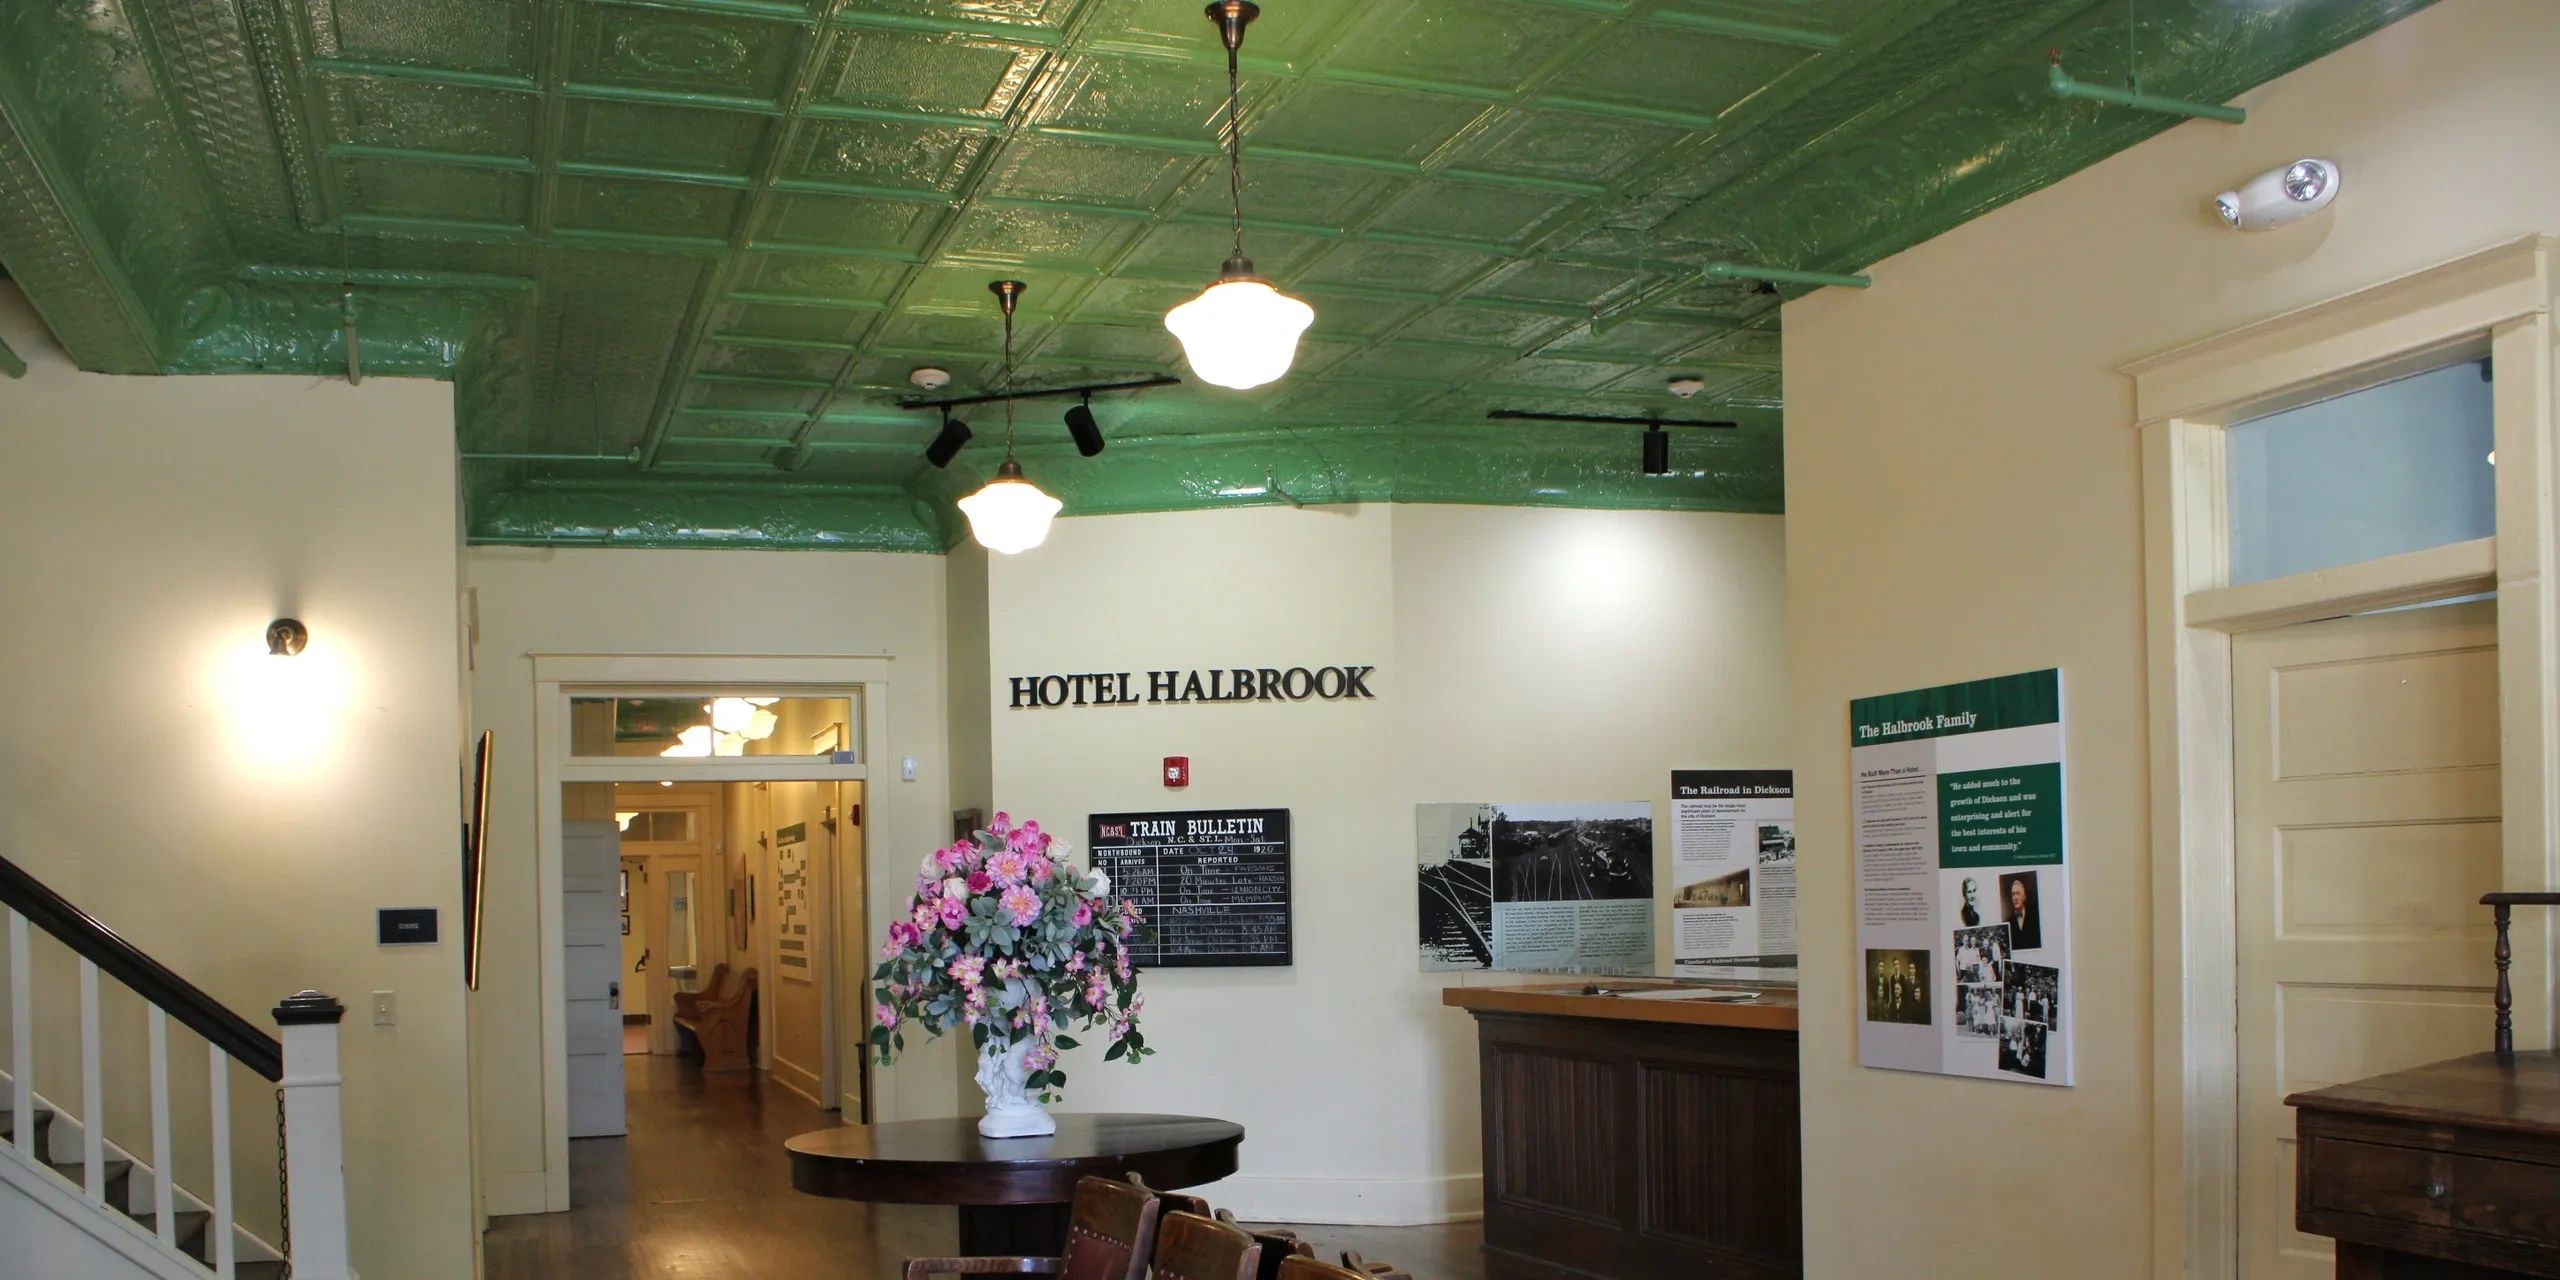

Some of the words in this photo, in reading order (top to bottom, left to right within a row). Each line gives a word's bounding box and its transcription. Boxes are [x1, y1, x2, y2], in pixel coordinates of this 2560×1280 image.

[1009, 672, 1140, 708] HOTEL
[1147, 666, 1375, 702] HALBROOK
[1859, 725, 1880, 738] The
[1882, 717, 1934, 736] Halbrook
[1936, 711, 1977, 729] Family
[1962, 780, 1981, 789] added
[1982, 779, 2000, 788] much
[2009, 777, 2021, 785] the
[1680, 786, 1698, 795] The
[1700, 786, 1740, 795] Railroad
[1742, 786, 1752, 794] in
[1754, 785, 1791, 794] Dickson
[1950, 797, 1973, 808] growth
[1973, 796, 1981, 804] of
[1981, 795, 2008, 804] Dickson
[2008, 793, 2022, 801] and
[1950, 812, 1990, 822] enterprising
[1990, 811, 2003, 819] and
[2004, 810, 2021, 818] alert
[2021, 809, 2032, 817] for
[1130, 820, 1176, 837] TRAIN
[1187, 818, 1264, 836] BULLETIN
[1951, 828, 1962, 837] the
[1962, 828, 1976, 836] best
[1977, 827, 2007, 836] interests
[2007, 826, 2015, 834] of
[2015, 825, 2027, 833] his
[1126, 836, 1161, 846] Dickson
[1097, 849, 1142, 857] NORTHBOUND
[1163, 847, 1184, 855] DATE
[1951, 845, 1967, 853] town
[1968, 844, 1981, 852] and
[1197, 856, 1239, 864] REPORTED
[1180, 865, 1193, 875] On
[1200, 864, 1221, 875] Time
[1180, 875, 1192, 885] 20
[1179, 886, 1191, 895] On
[1180, 895, 1192, 904] On
[1172, 906, 1231, 915] NASHVILLE
